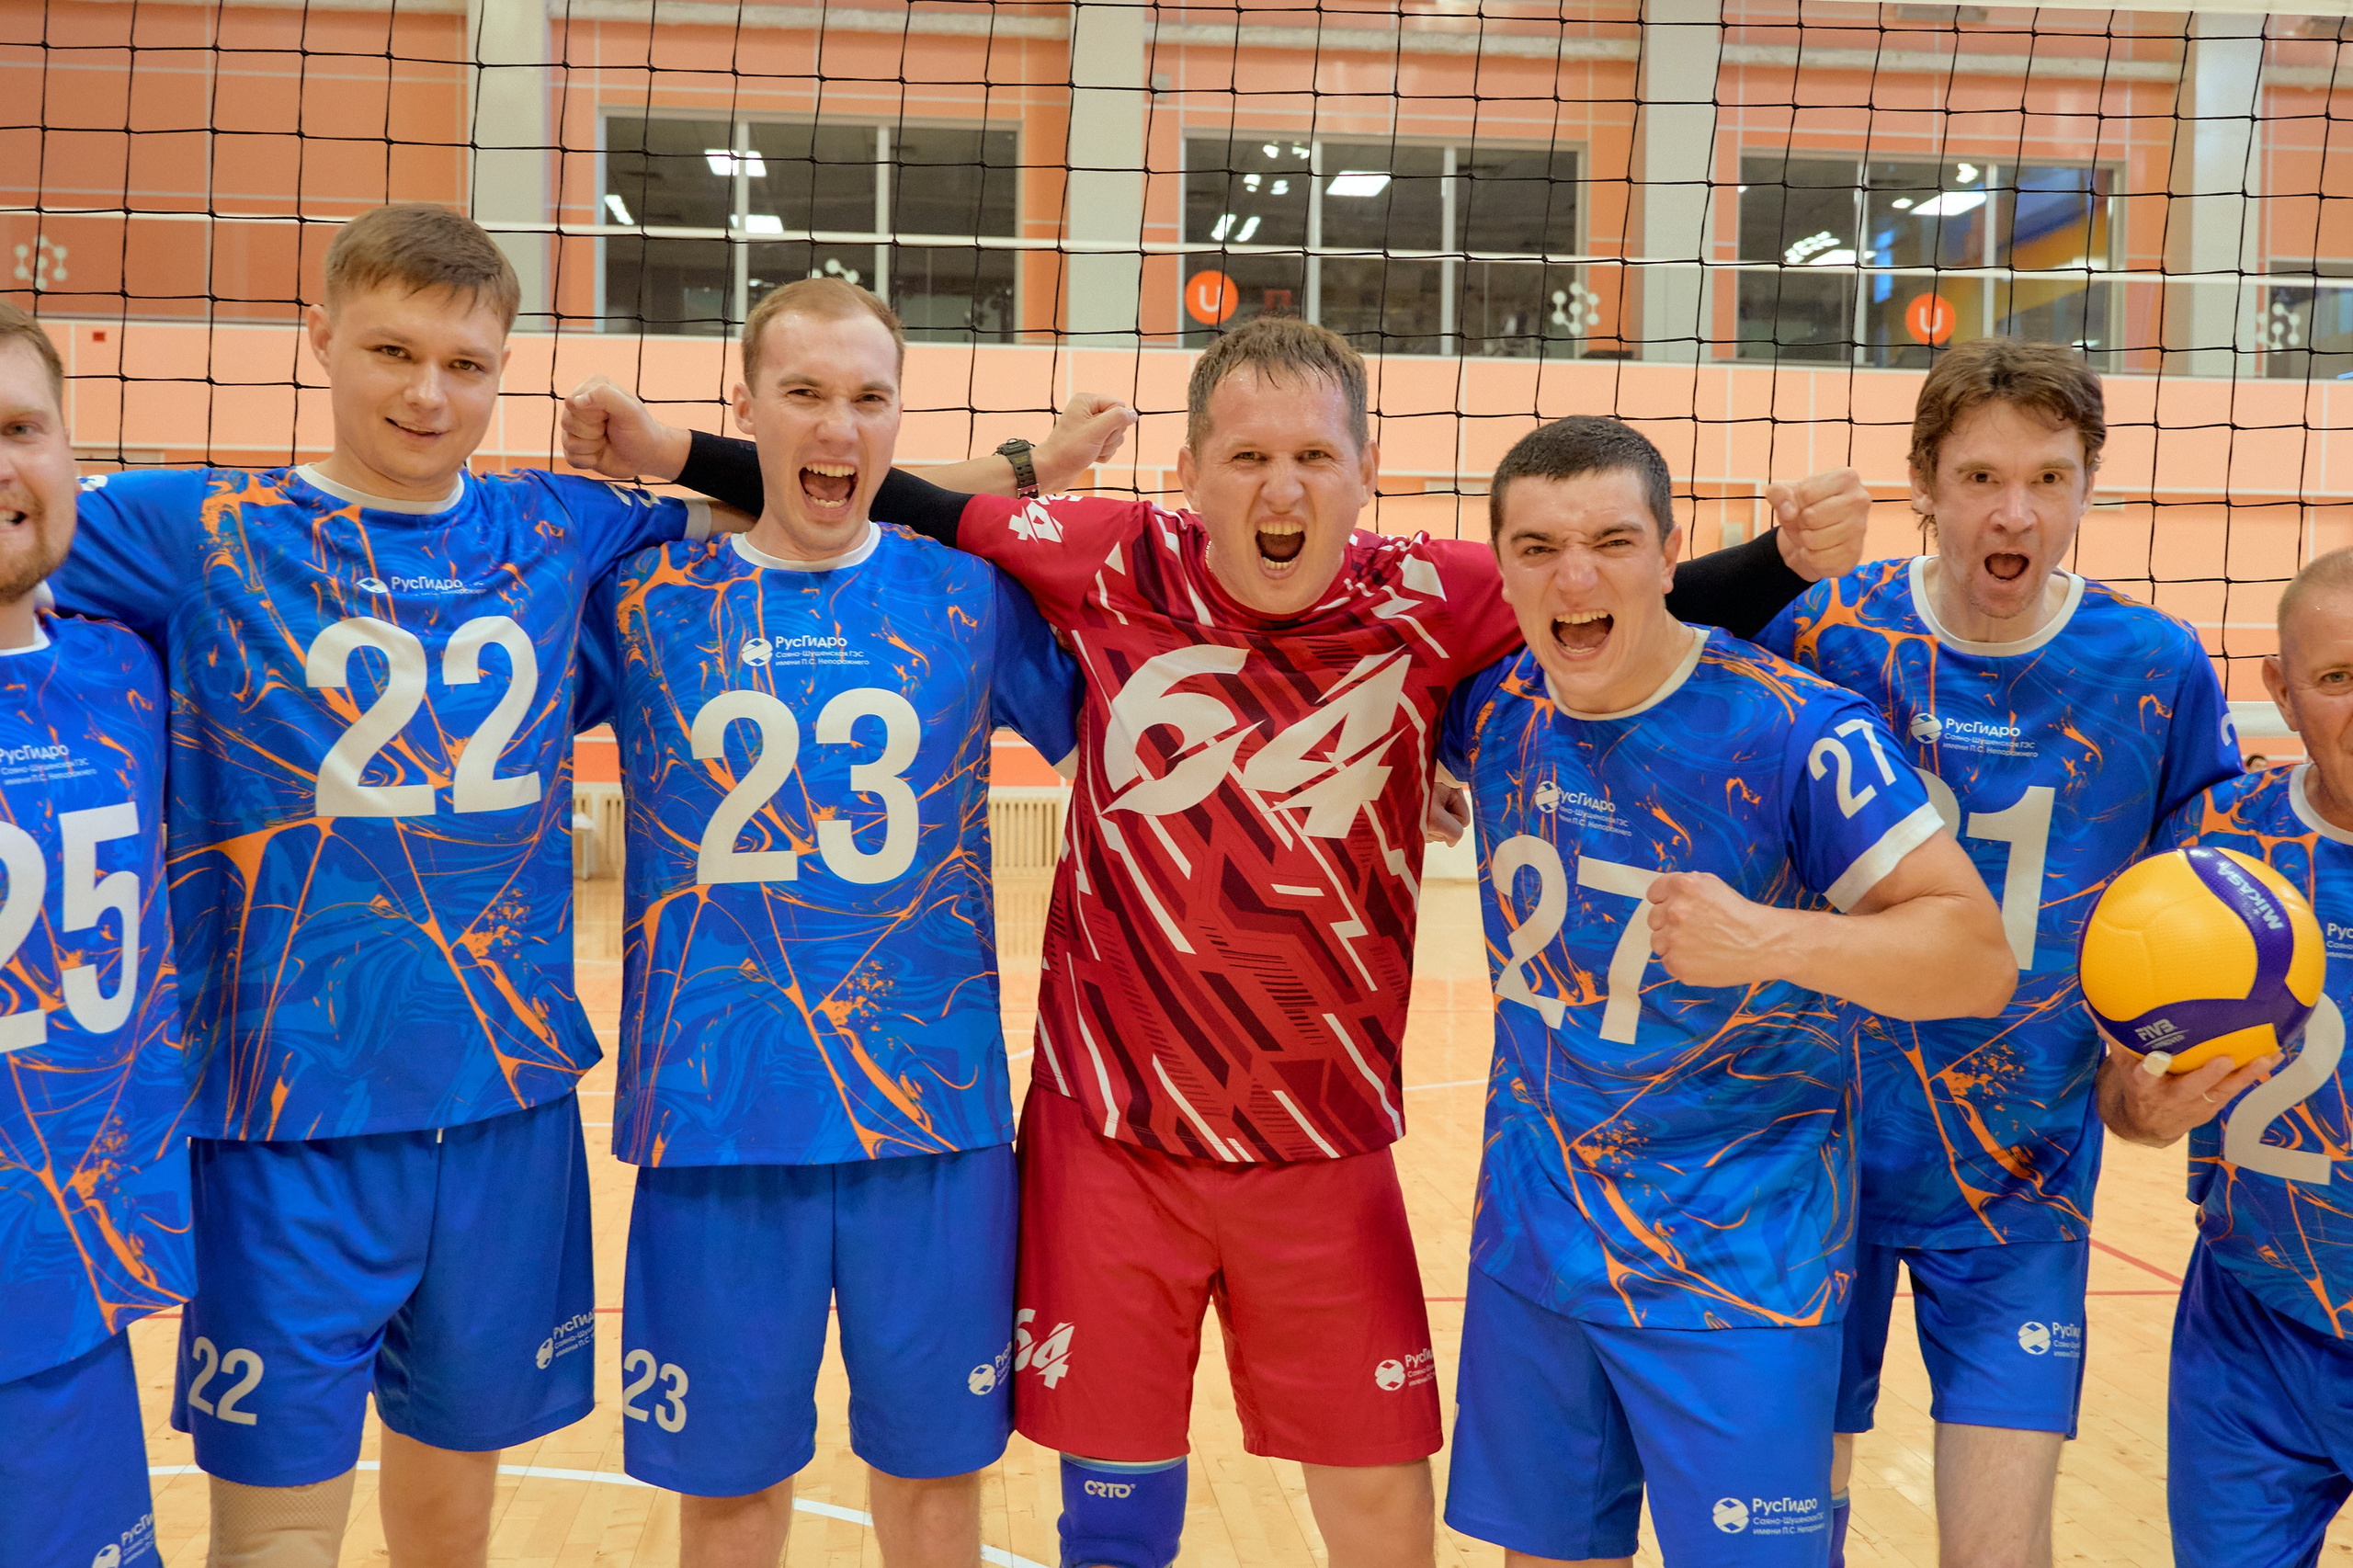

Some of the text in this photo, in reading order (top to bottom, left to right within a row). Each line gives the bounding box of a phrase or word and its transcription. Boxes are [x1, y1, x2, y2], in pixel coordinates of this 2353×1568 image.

[392, 575, 463, 592] РусГидро
[775, 634, 847, 650] РусГидро
[848, 650, 864, 658] ГЭС
[305, 615, 542, 818] 22
[1100, 643, 1412, 839] 64
[1945, 718, 2021, 738] РусГидро
[2019, 741, 2037, 750] ГЭС
[690, 687, 921, 884] 23
[1808, 719, 1898, 820] 27
[1914, 767, 2056, 971] 1
[0, 801, 140, 1053] 25
[1492, 835, 1665, 1045] 27
[2134, 1018, 2175, 1040] FIVB
[188, 1335, 265, 1426] 22
[622, 1348, 688, 1433] 23
[1752, 1496, 1817, 1516] РусГидро
